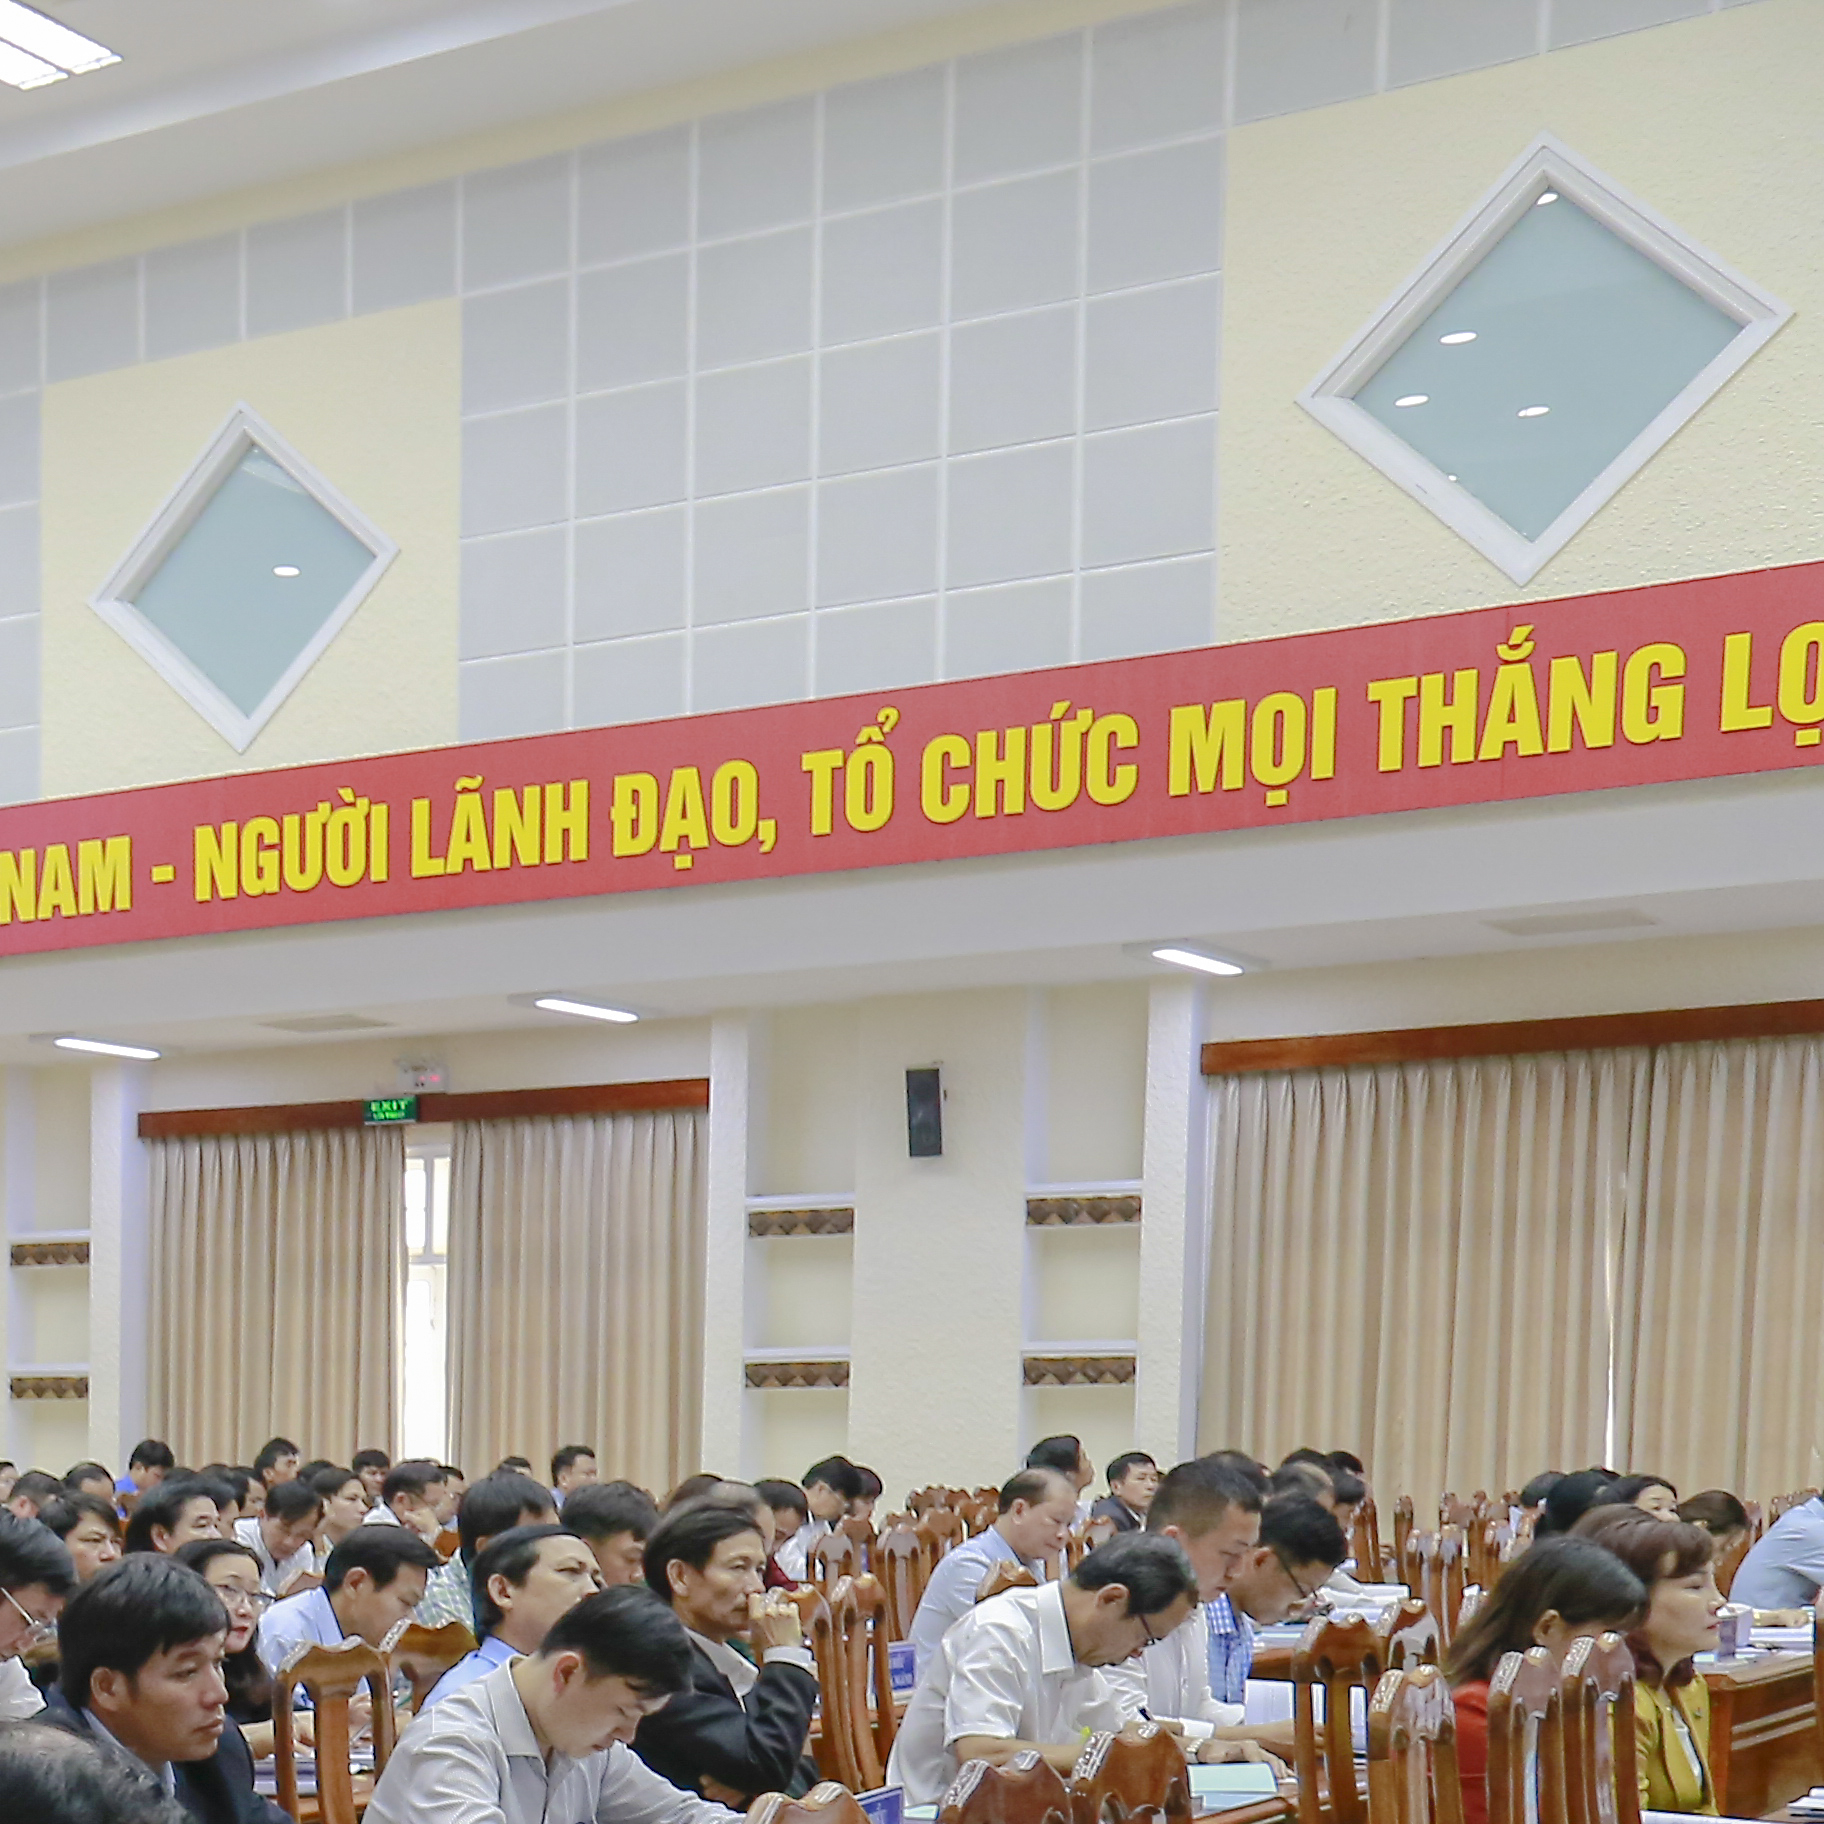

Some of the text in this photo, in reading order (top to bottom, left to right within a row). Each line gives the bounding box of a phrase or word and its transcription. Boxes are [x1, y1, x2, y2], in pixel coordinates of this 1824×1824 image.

[192, 786, 389, 904] NGƯỜI
[409, 773, 589, 878] LÃNH
[609, 759, 777, 871] ĐẠO,
[801, 706, 899, 837] TỔ
[919, 699, 1140, 825] CHỨC
[1166, 686, 1339, 809] MỌI
[1366, 625, 1688, 773] THẮNG
